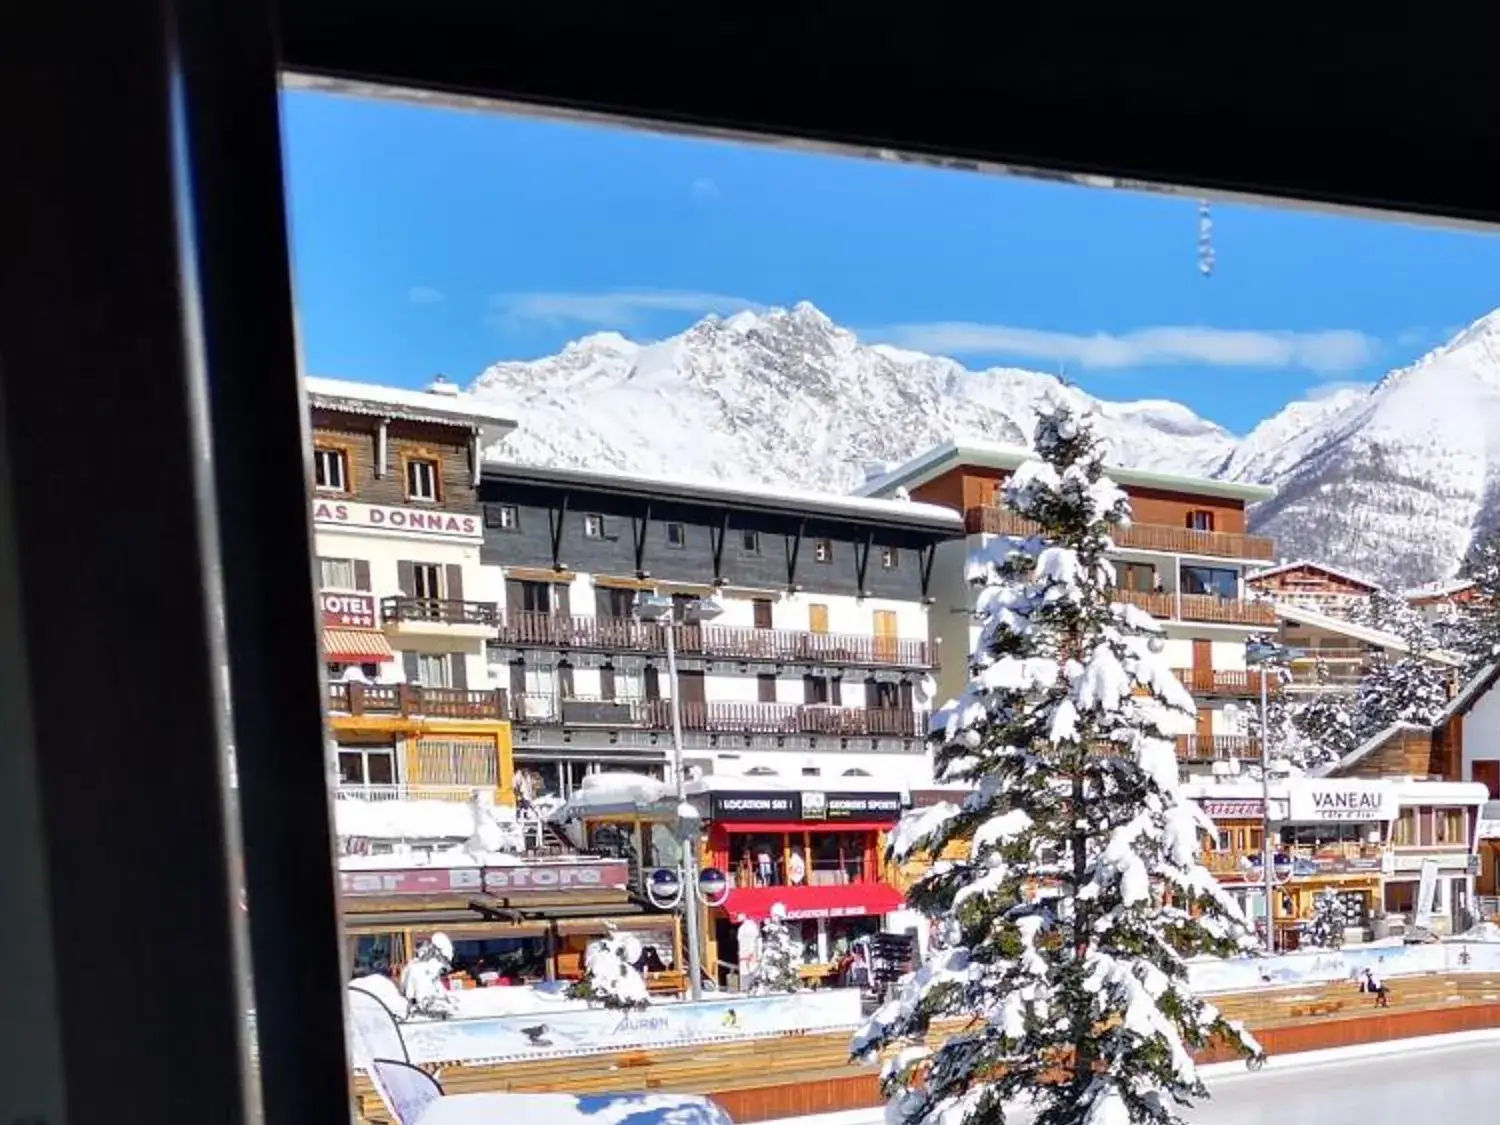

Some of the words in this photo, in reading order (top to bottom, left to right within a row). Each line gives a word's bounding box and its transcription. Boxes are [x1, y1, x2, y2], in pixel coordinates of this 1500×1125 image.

[370, 509, 475, 533] DONNAS
[723, 799, 771, 810] LOCATION
[1312, 792, 1382, 808] VANEAU
[450, 866, 601, 889] Before
